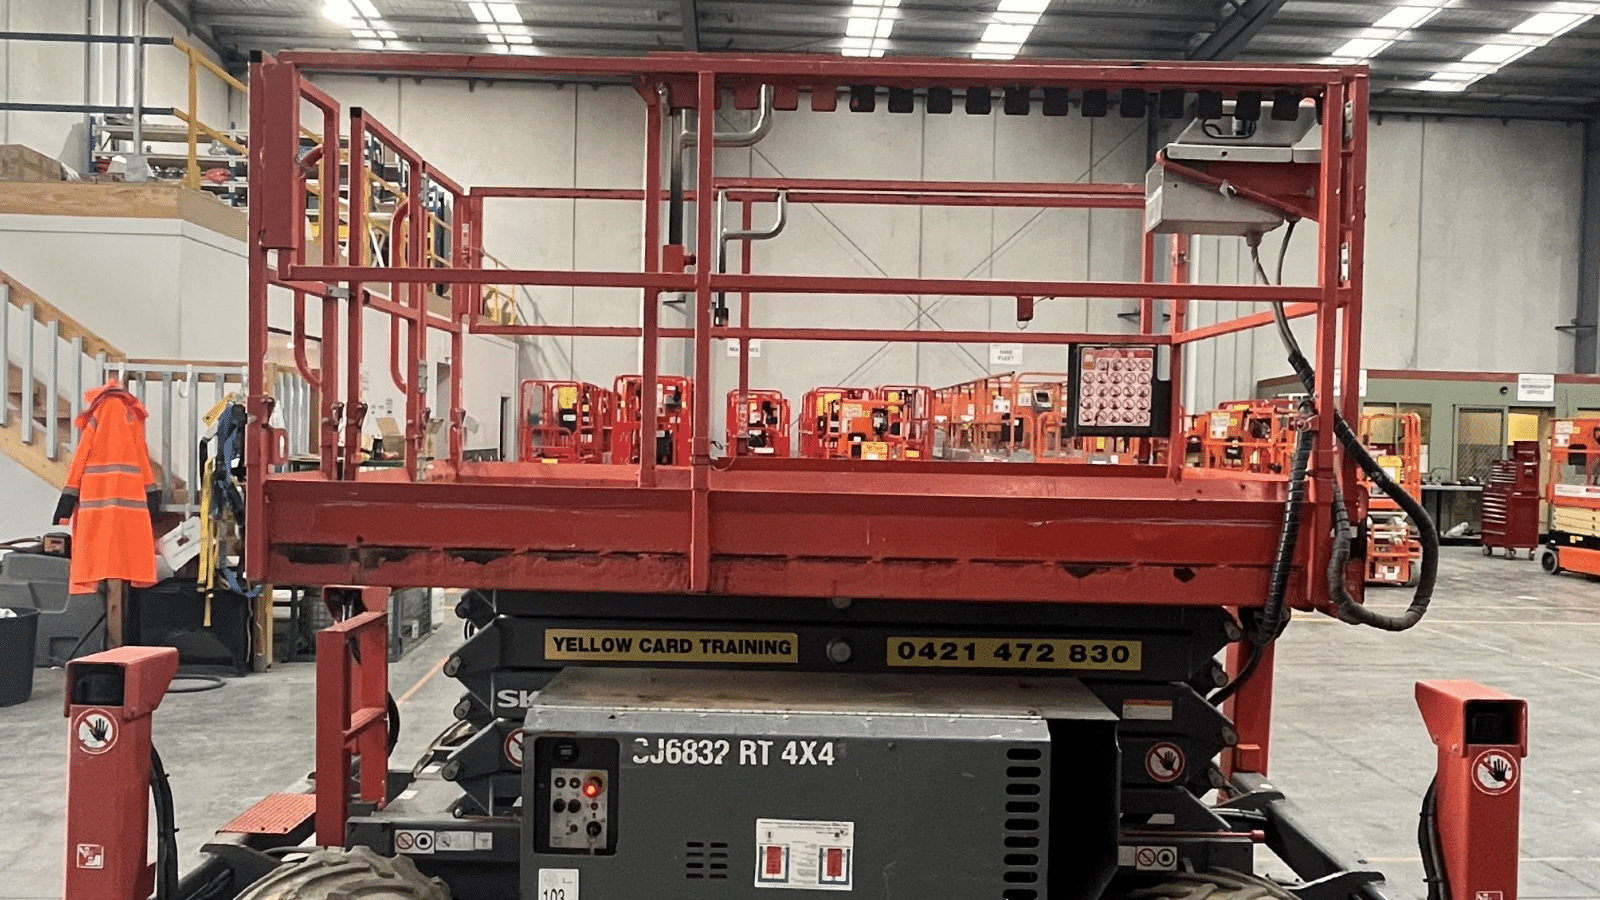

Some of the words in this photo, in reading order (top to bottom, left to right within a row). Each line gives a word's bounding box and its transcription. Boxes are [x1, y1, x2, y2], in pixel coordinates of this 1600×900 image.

[553, 636, 633, 653] YELLOW
[638, 638, 693, 654] CARD
[699, 639, 792, 655] TRAINING
[897, 641, 976, 661] 0421
[993, 643, 1055, 663] 472
[1068, 644, 1130, 663] 830
[739, 740, 774, 765] RT
[781, 740, 835, 766] 4X4
